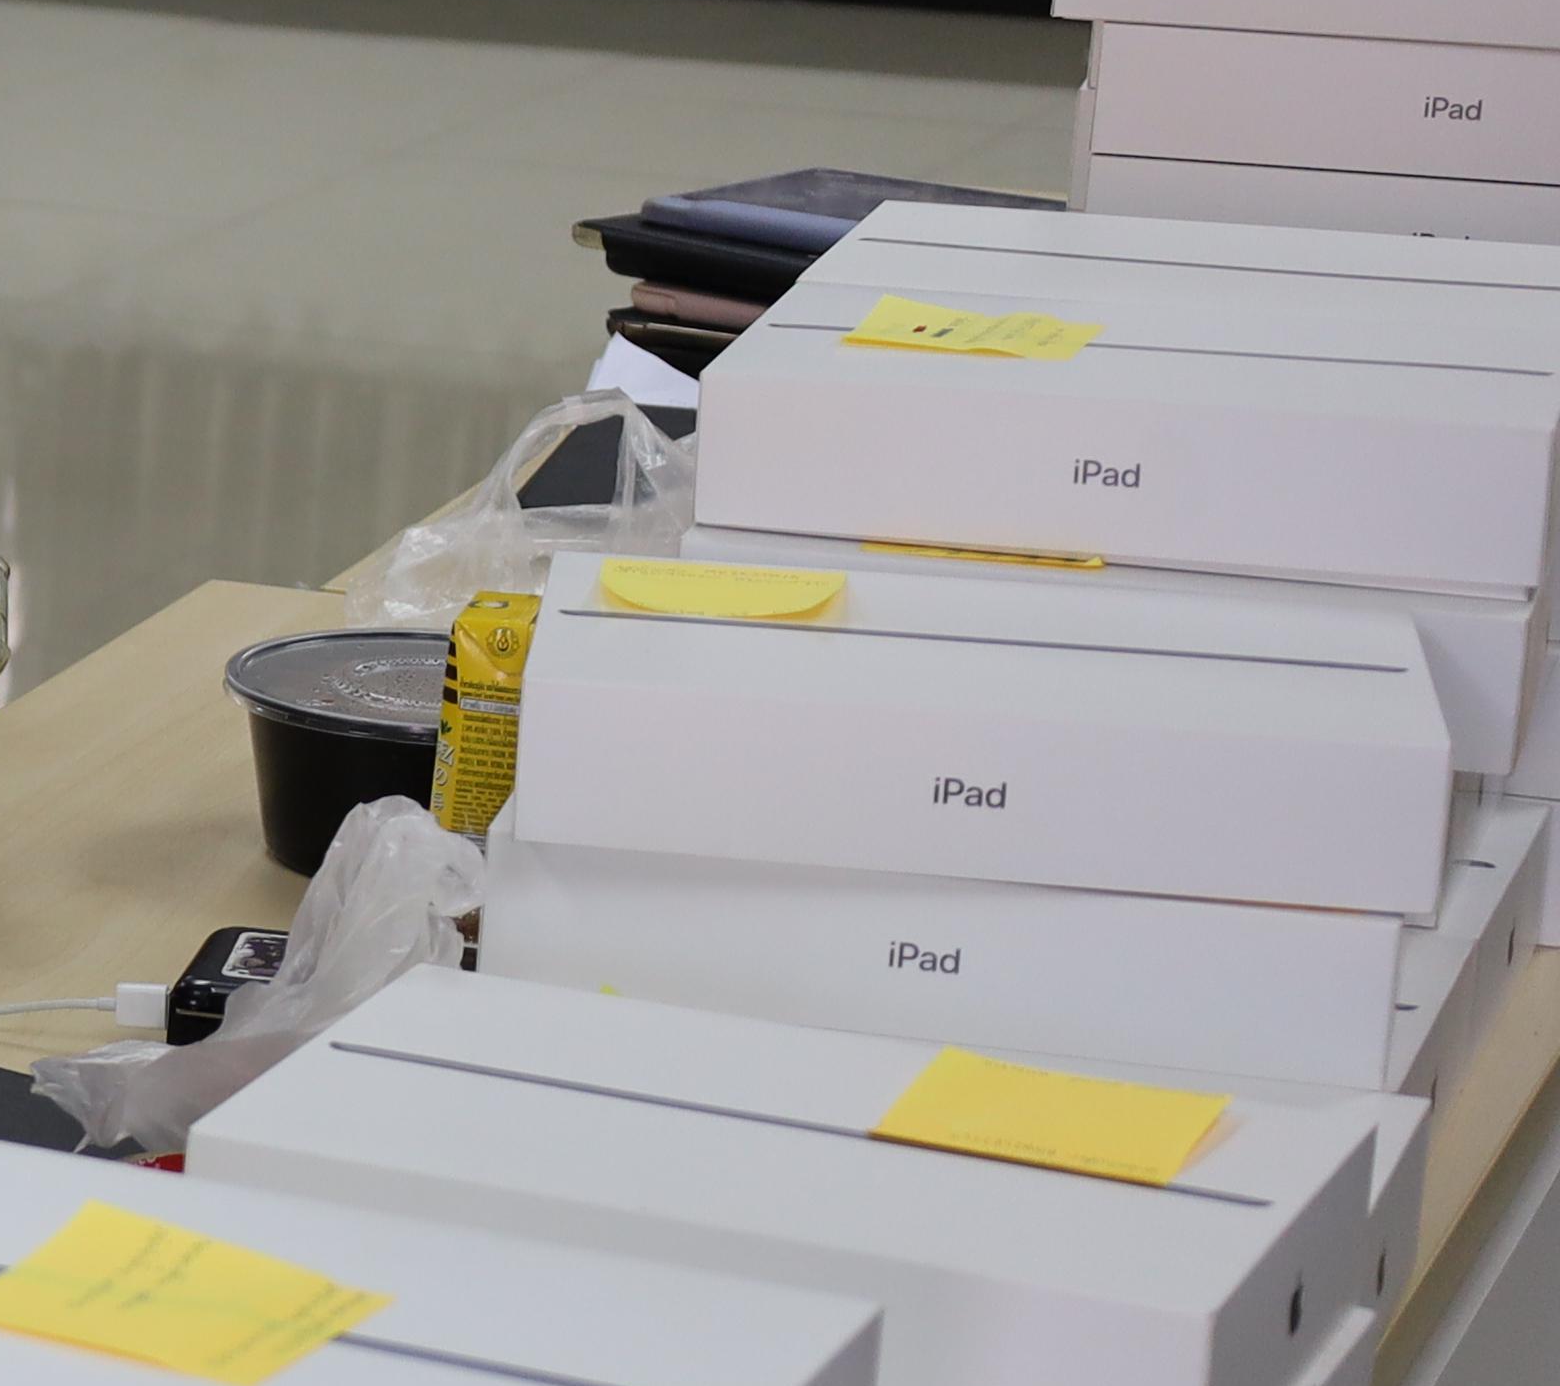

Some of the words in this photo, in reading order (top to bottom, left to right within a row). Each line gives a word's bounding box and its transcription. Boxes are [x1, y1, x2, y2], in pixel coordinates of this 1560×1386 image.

[1423, 96, 1483, 121] iPad
[1073, 458, 1141, 489] iPad
[933, 777, 1007, 809] iPad
[888, 941, 961, 975] iPad
